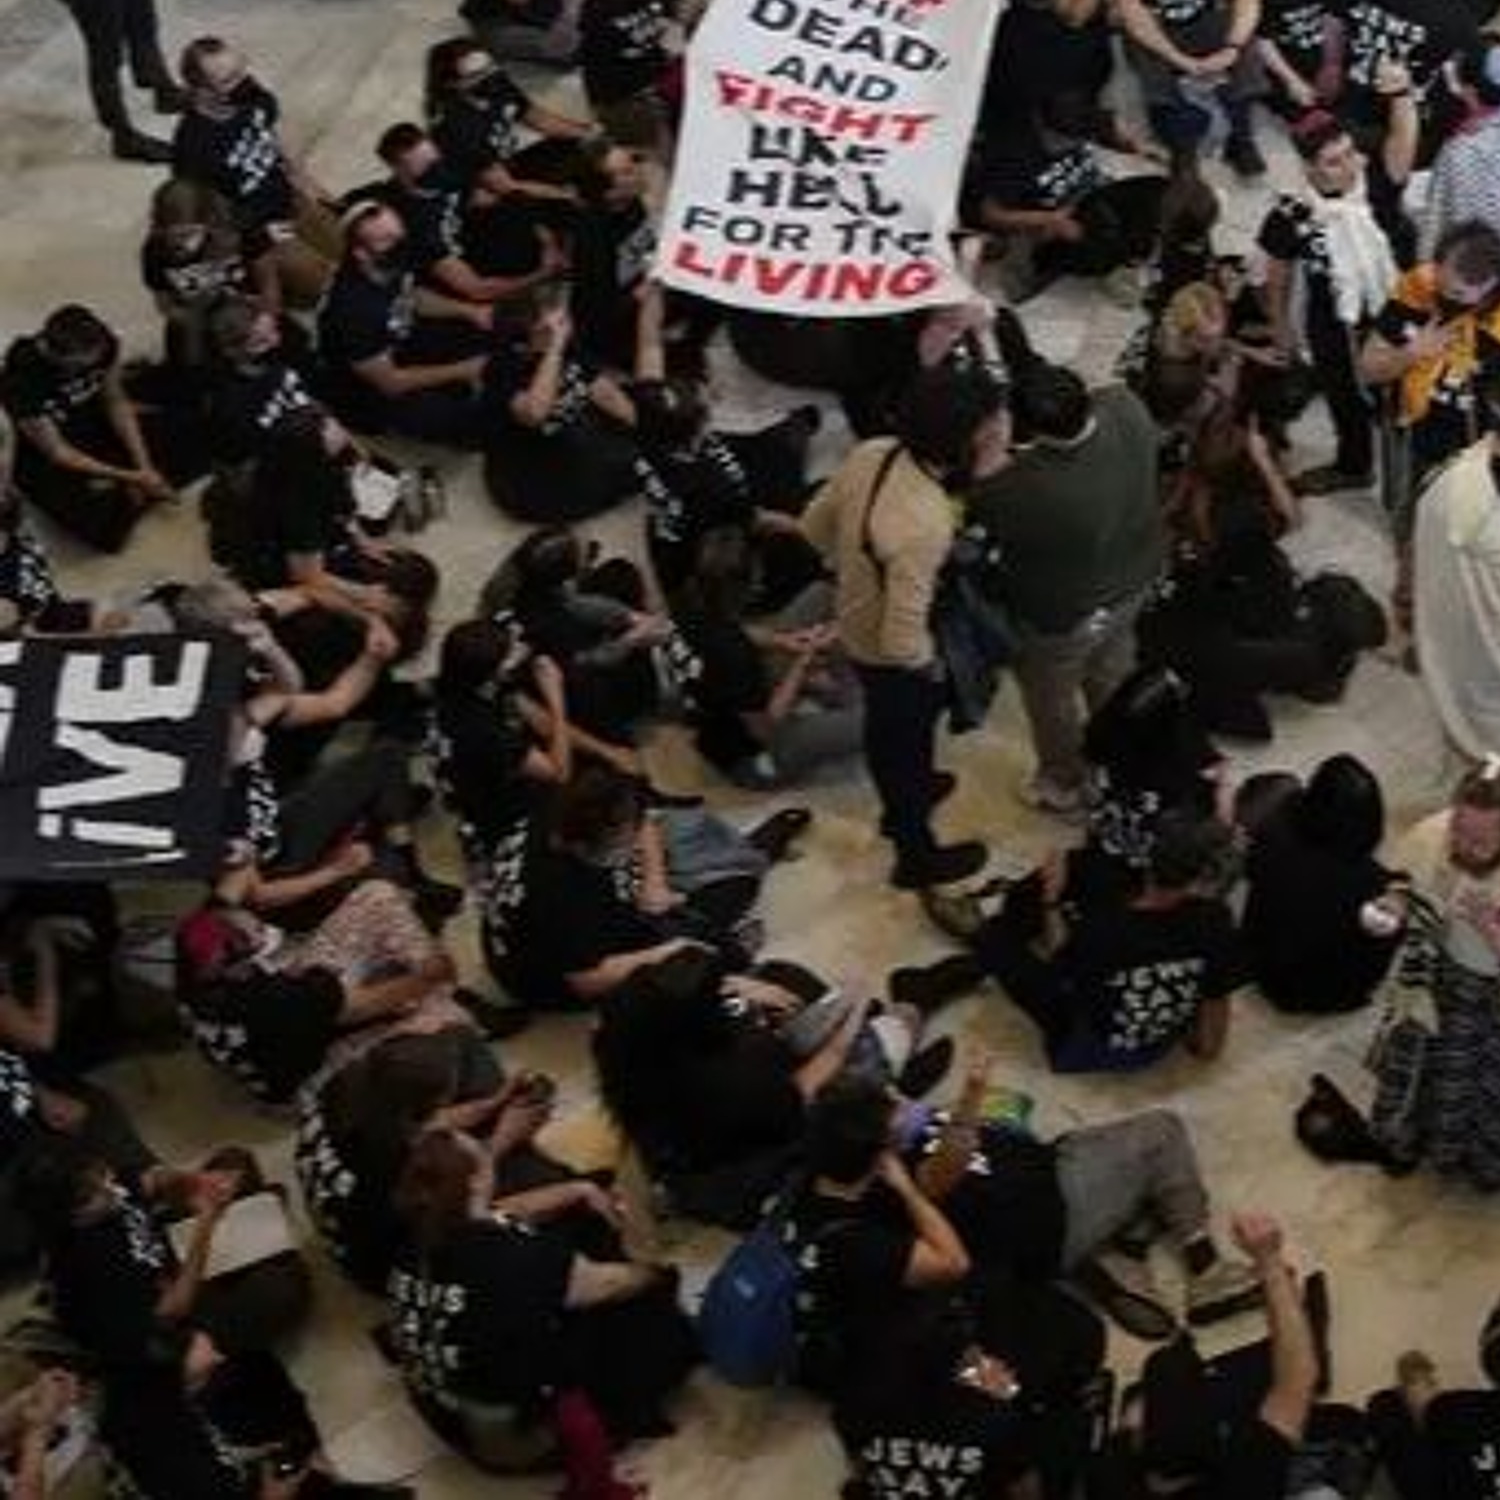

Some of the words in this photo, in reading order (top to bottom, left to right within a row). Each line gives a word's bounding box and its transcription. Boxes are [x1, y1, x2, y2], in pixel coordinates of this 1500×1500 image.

[767, 56, 899, 103] AND
[713, 70, 938, 143] FIGHT
[681, 205, 810, 253] FOR
[672, 242, 939, 301] LIVING
[862, 1436, 984, 1475] JEWS
